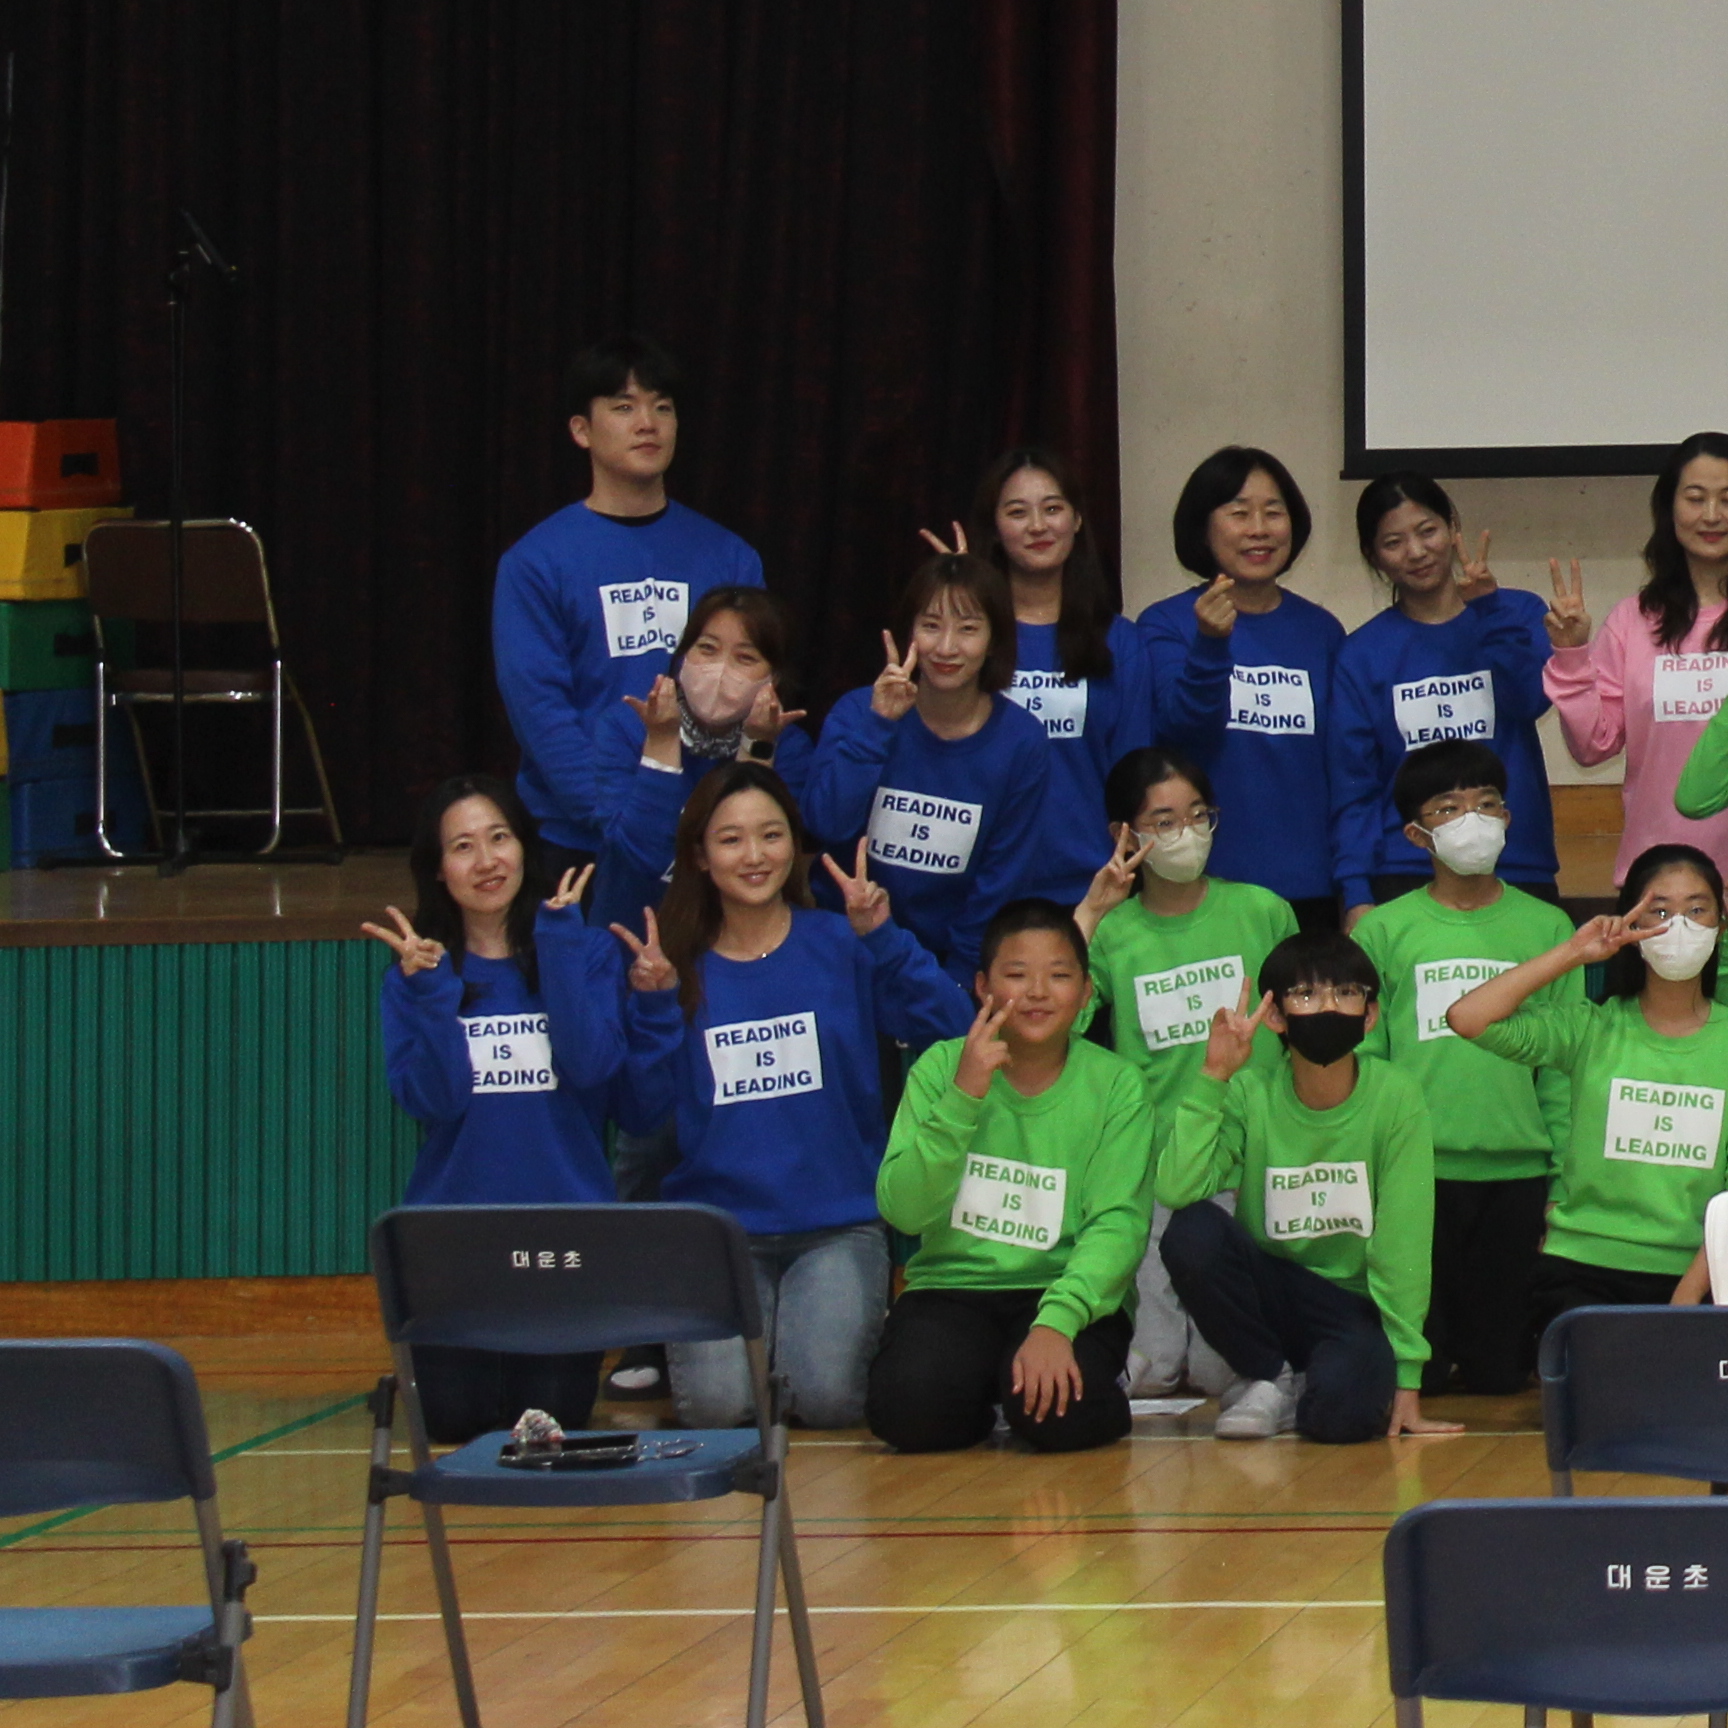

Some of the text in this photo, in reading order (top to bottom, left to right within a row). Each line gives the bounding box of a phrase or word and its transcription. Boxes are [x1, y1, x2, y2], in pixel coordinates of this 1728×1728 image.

[1010, 674, 1079, 689] EADING
[1401, 676, 1485, 702] READING
[1697, 678, 1713, 692] IS
[1026, 697, 1043, 711] IS
[1256, 693, 1272, 706] IS
[1437, 704, 1454, 718] IS
[1406, 719, 1487, 744] LEADING
[881, 795, 973, 825] READING
[911, 824, 930, 840] IS
[870, 839, 961, 869] LEADING
[1144, 963, 1236, 997] READING
[1187, 995, 1203, 1011] IS
[466, 1019, 549, 1038] EADING
[715, 1020, 807, 1048] READING
[493, 1045, 512, 1060] IS
[756, 1051, 776, 1067] IS
[472, 1069, 550, 1086] EADING
[722, 1070, 813, 1098] LEADING
[1620, 1085, 1715, 1110] READING
[1654, 1116, 1674, 1132] IS
[1615, 1137, 1707, 1161] LEADING
[969, 1160, 1057, 1191] READING
[1002, 1193, 1022, 1211] IS
[1311, 1191, 1327, 1207] IS
[962, 1212, 1048, 1243] LEADING
[1274, 1216, 1363, 1234] LEADING
[1607, 1563, 1709, 1591] 대운초
